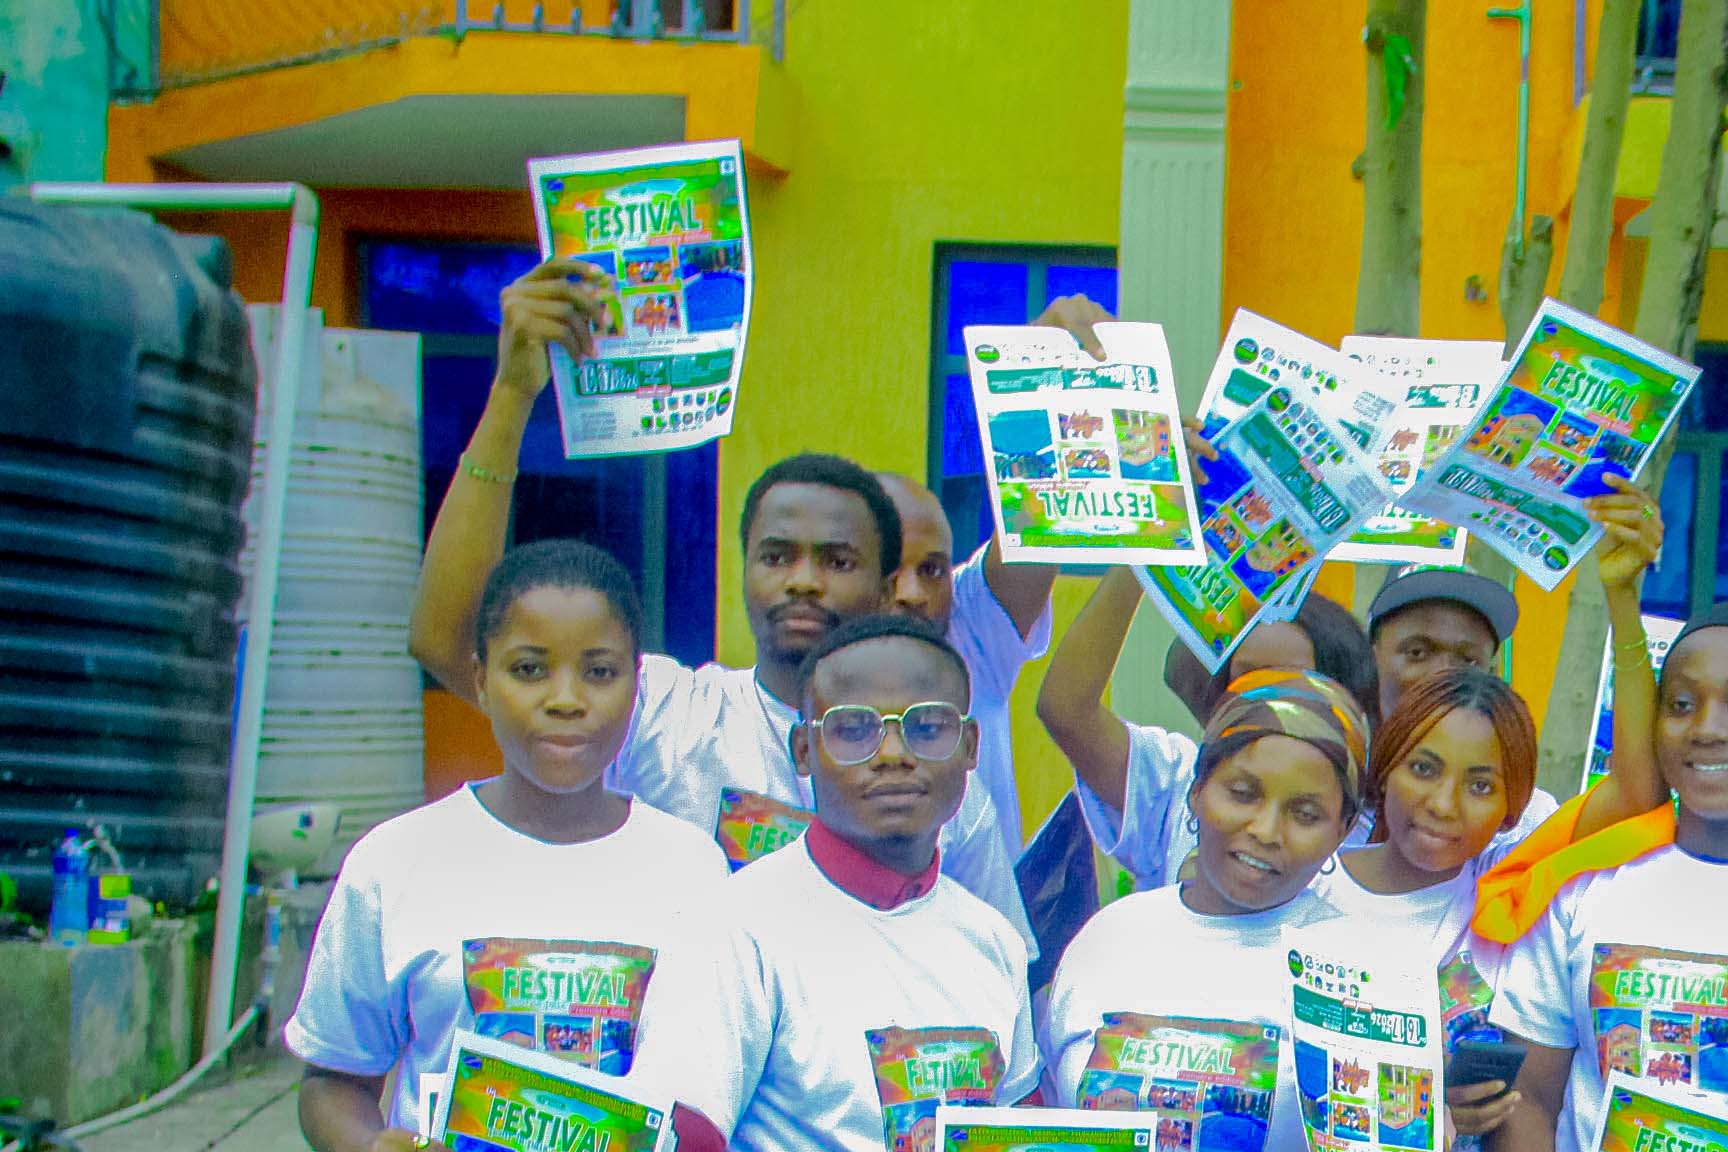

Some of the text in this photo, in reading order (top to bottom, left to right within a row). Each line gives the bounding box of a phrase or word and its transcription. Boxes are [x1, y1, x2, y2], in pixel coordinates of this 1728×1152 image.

[583, 197, 703, 241] FESTIVAL
[1542, 359, 1641, 424] FESTIVAL
[1036, 490, 1157, 520] FESTIVAL
[502, 967, 631, 1008] FESTIVAL
[1614, 969, 1728, 1007] FESTIVAL
[1118, 1036, 1237, 1075] FESTIVAL
